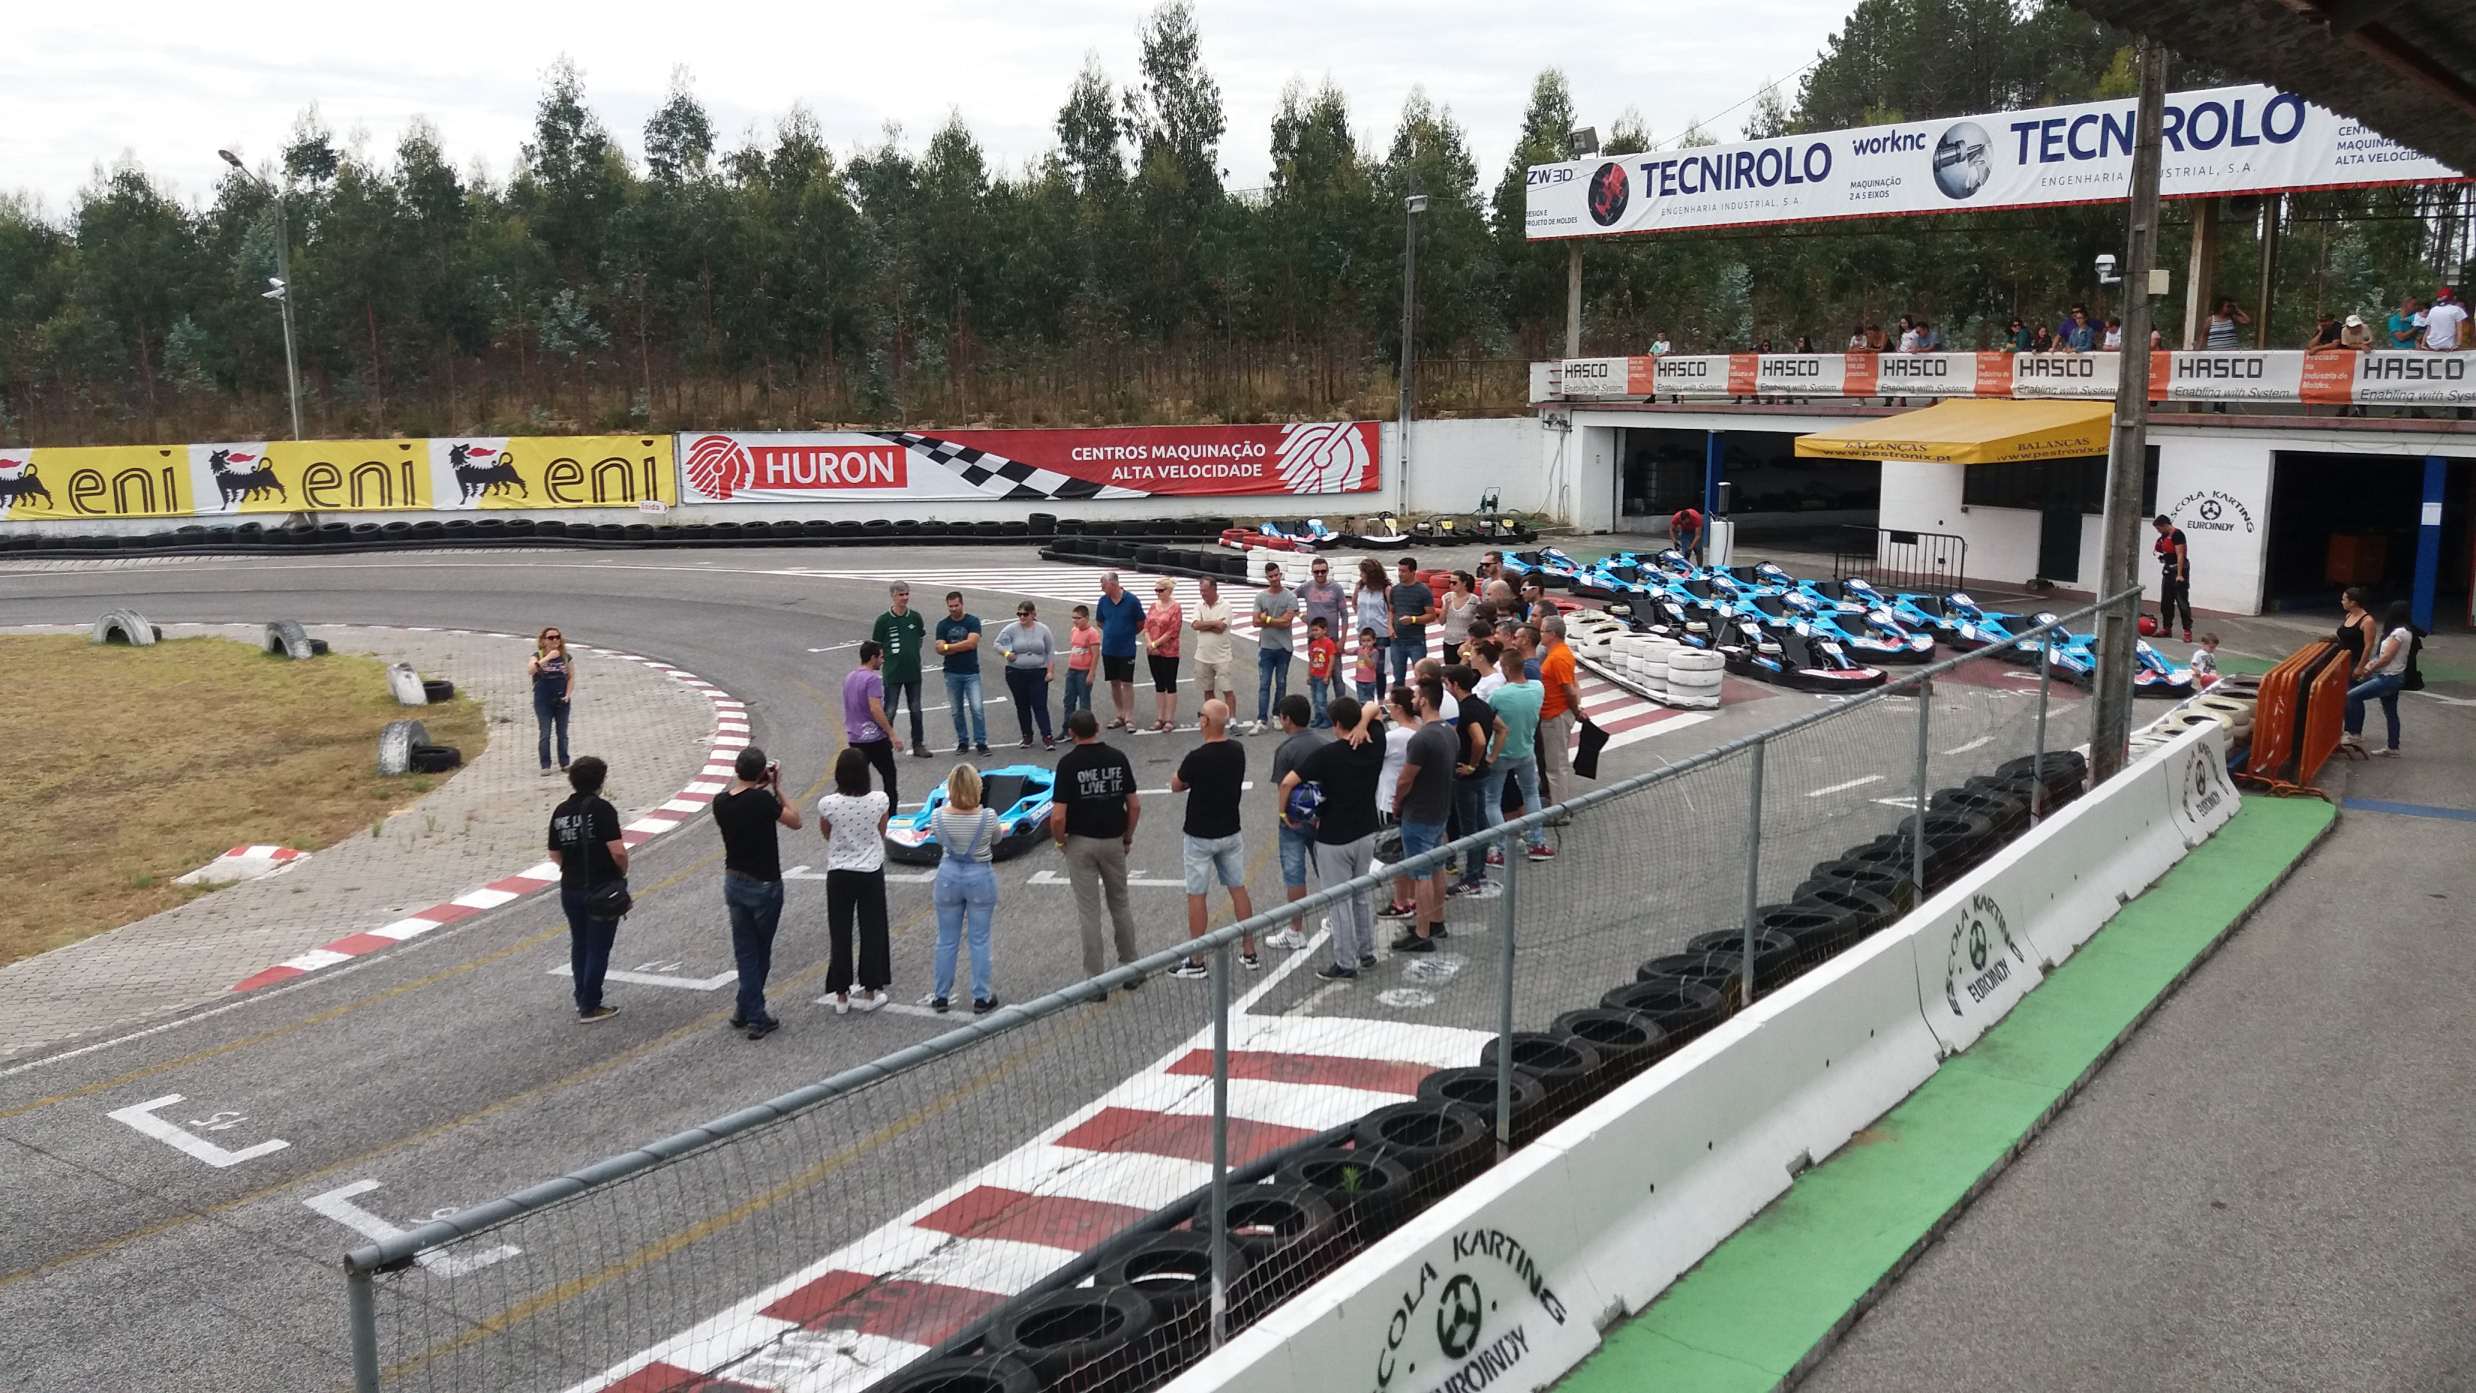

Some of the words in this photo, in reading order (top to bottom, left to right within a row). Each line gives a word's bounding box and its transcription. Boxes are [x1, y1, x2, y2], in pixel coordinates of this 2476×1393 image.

[2010, 93, 2305, 165] TECNROLO
[2338, 125, 2370, 136] CENT
[1852, 129, 1926, 156] worknc
[2337, 139, 2394, 151] MAQUINA
[2335, 154, 2364, 165] ALTA
[2368, 150, 2429, 162] VELOCID
[1526, 168, 1573, 185] ZW3D
[1640, 143, 1832, 198] TECNIROLO
[2041, 172, 2124, 187] ENGENHARIA
[2160, 164, 2220, 178] STRIAL,
[1850, 176, 1902, 190] MAQUINAÇÃO
[1849, 192, 1854, 201] 2
[1855, 192, 1861, 200] A
[1868, 190, 1890, 199] EIXOS
[1661, 203, 1717, 217] ENGENHARIA
[1565, 363, 1607, 379] HASCO
[1658, 361, 1706, 377] HASCO
[1762, 360, 1819, 377] HASCO
[1884, 359, 1947, 377] HASCO
[2020, 358, 2093, 378] HASCO
[2178, 358, 2263, 379] HASCO
[2363, 358, 2465, 380] HASCO
[2175, 386, 2221, 399] Enabling
[2359, 388, 2414, 402] Enabling
[2419, 389, 2444, 401] with
[2447, 389, 2476, 402] Syst
[1071, 445, 1147, 461] CENTROS
[1151, 440, 1266, 461] MAQUINAÇÃO
[302, 444, 415, 508] eni
[544, 440, 657, 503] eni
[766, 451, 894, 484] HURON
[1111, 465, 1154, 480] ALTA
[1157, 463, 1262, 479] VELOCIDADE
[68, 450, 177, 514] eni
[2170, 490, 2205, 517] SCOLA
[2212, 490, 2255, 533] KARTING
[2187, 520, 2235, 531] EUROINDY
[1077, 768, 1099, 784] ONE
[1101, 766, 1123, 780] LIFE
[1080, 780, 1107, 796] LIVE
[573, 813, 594, 828] LIE
[1967, 958, 2012, 1004] EUROINDY
[1377, 1262, 1438, 1393] COLA
[1453, 1229, 1567, 1326] KARTING
[1434, 1324, 1529, 1393] ROINDY
